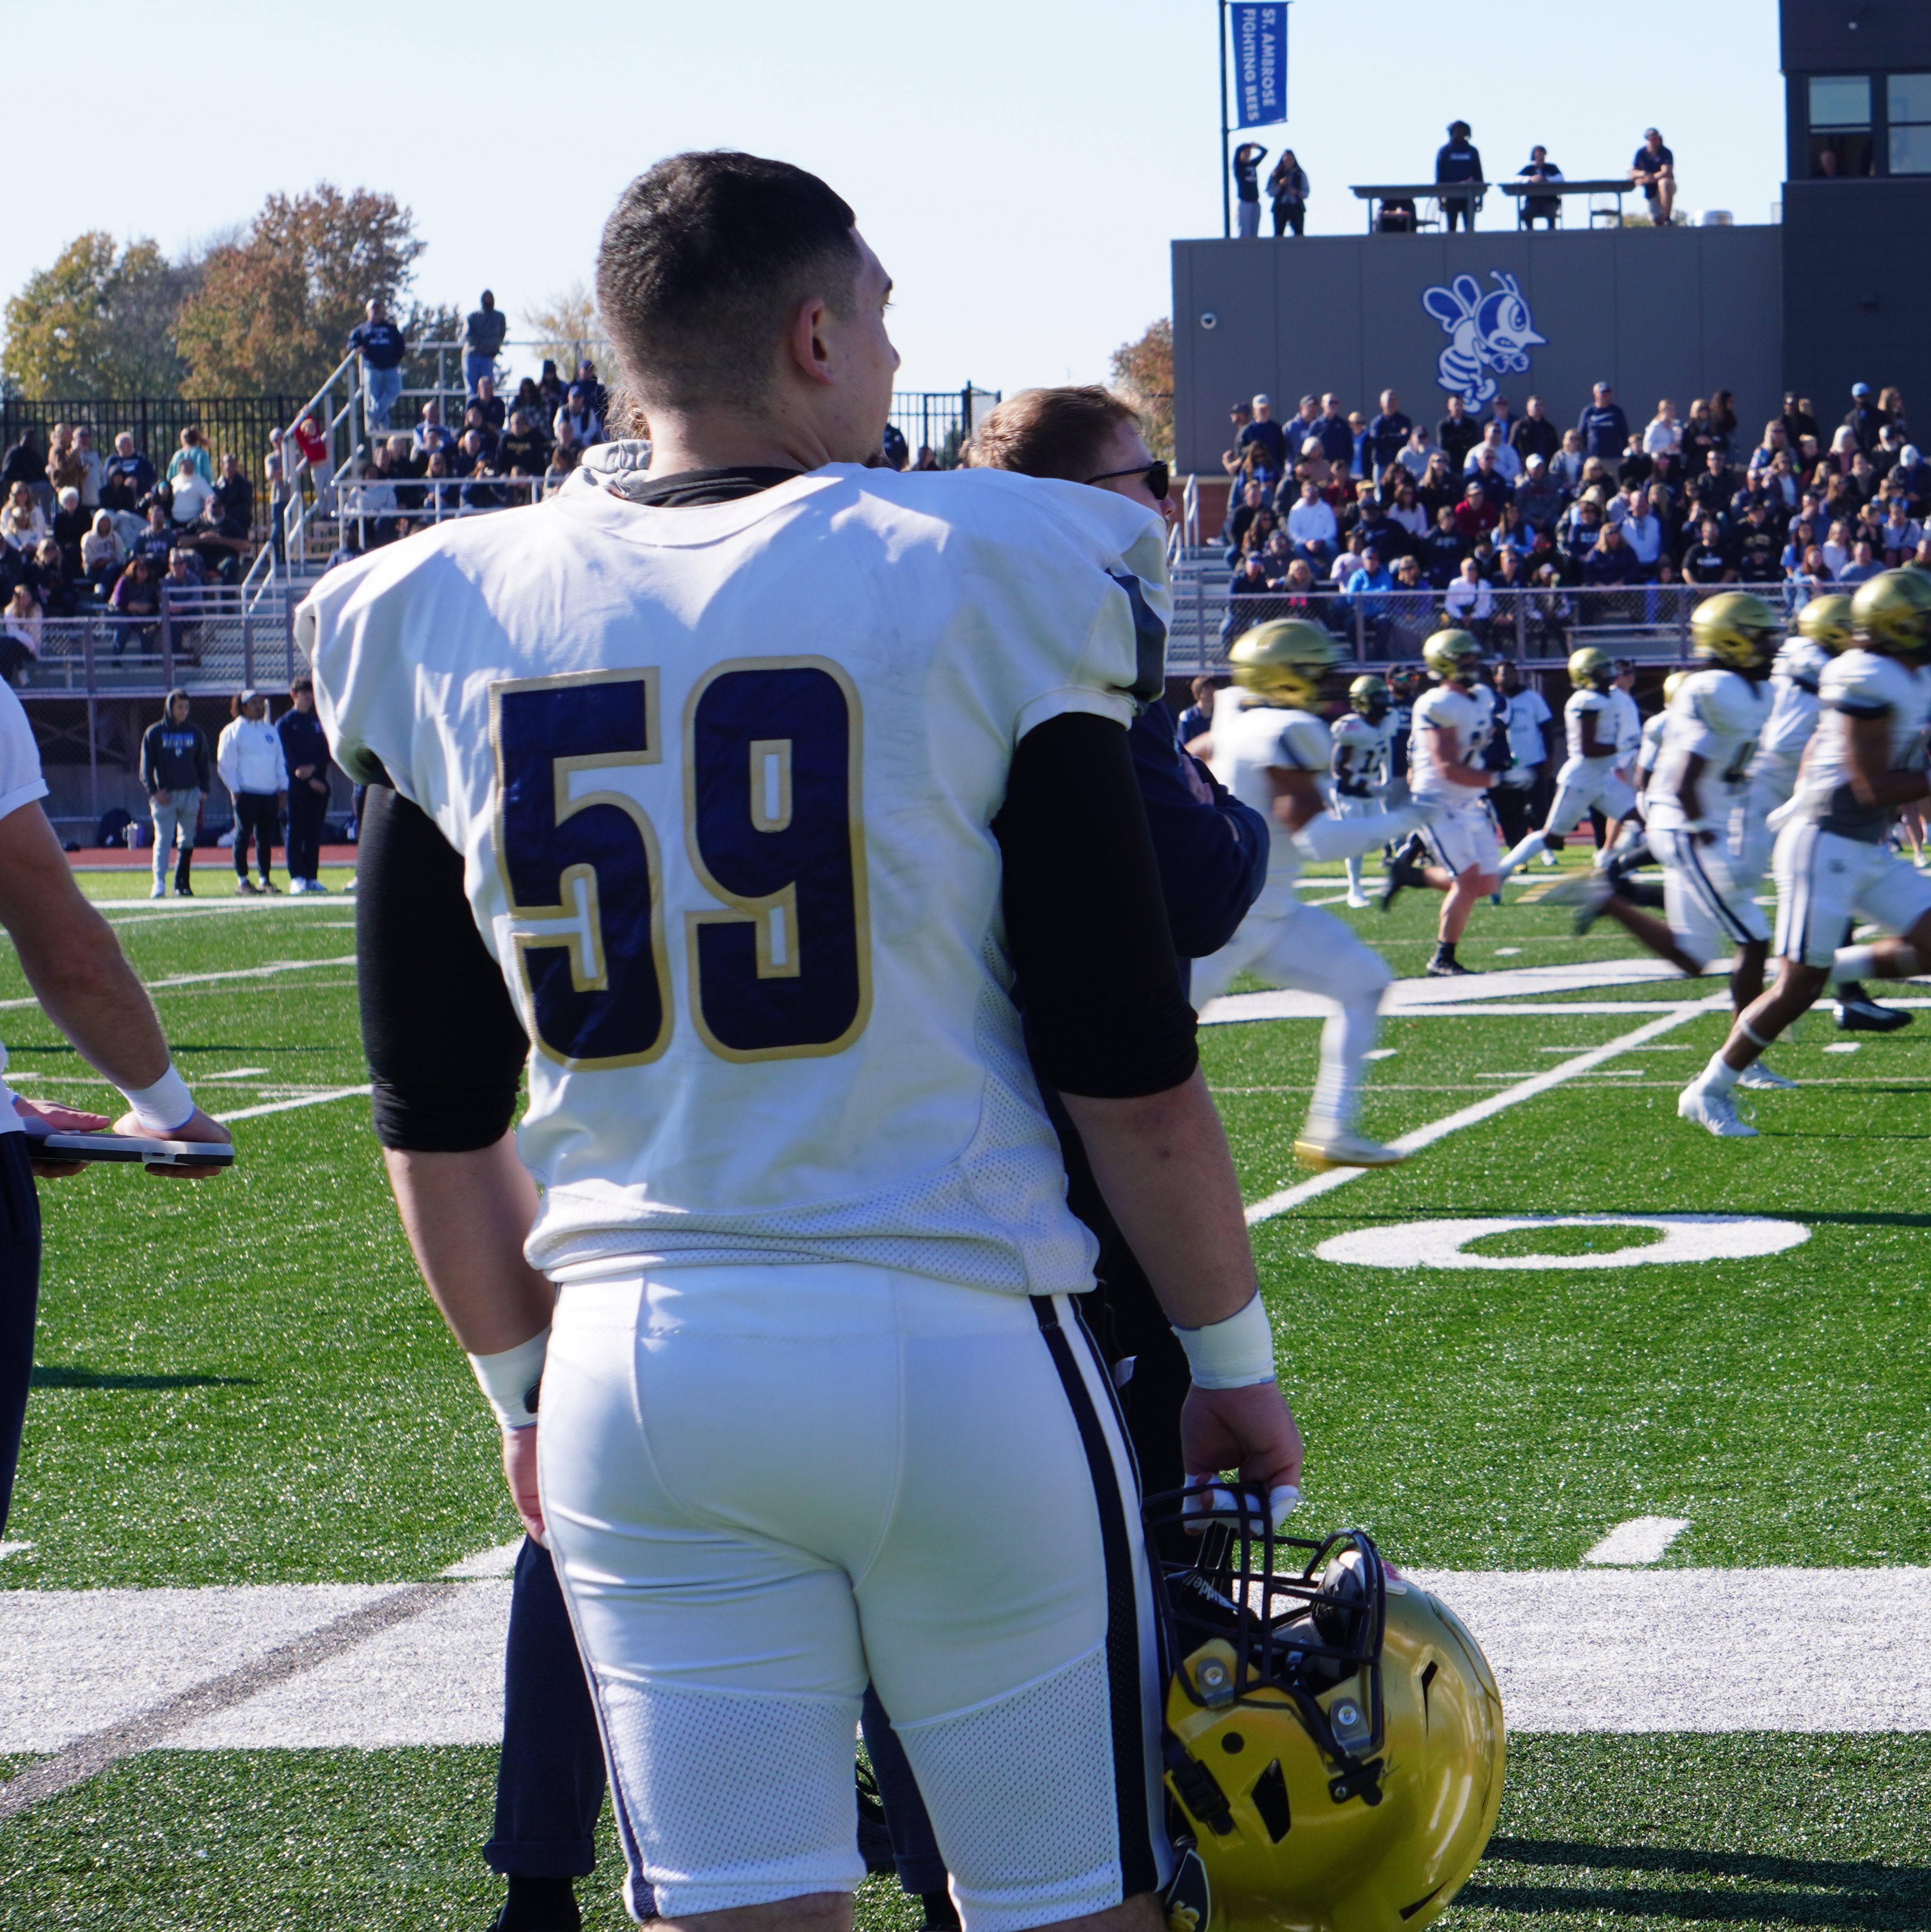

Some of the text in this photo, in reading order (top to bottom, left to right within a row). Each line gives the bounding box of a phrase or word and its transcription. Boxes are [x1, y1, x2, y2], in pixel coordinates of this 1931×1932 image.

[1242, 8, 1259, 121] FIGHTING BEES
[1261, 8, 1276, 107] ST. AMBROSE
[488, 654, 873, 1072] 59
